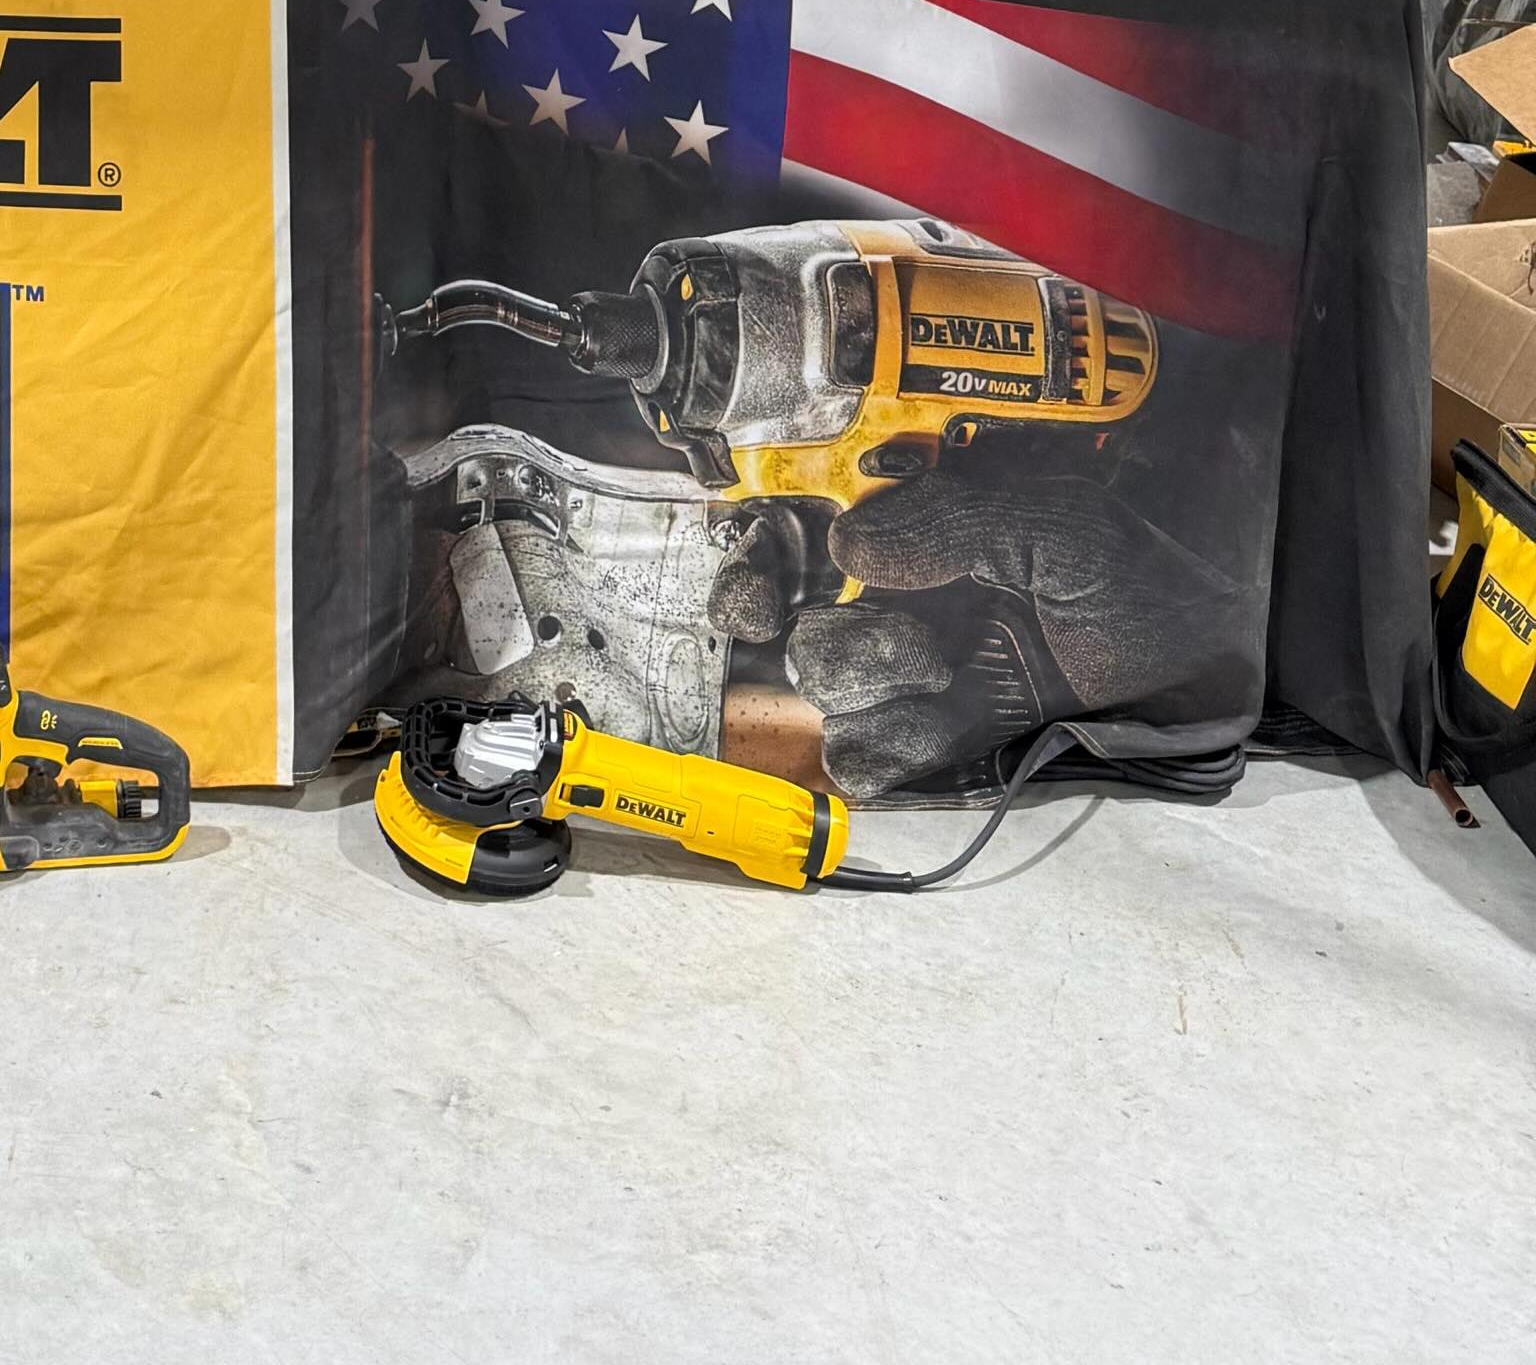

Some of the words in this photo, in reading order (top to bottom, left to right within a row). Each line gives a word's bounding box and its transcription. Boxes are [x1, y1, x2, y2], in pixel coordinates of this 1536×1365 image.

[988, 380, 1032, 396] MAX
[1478, 577, 1536, 644] DEWALT
[616, 795, 686, 826] DEWALT
